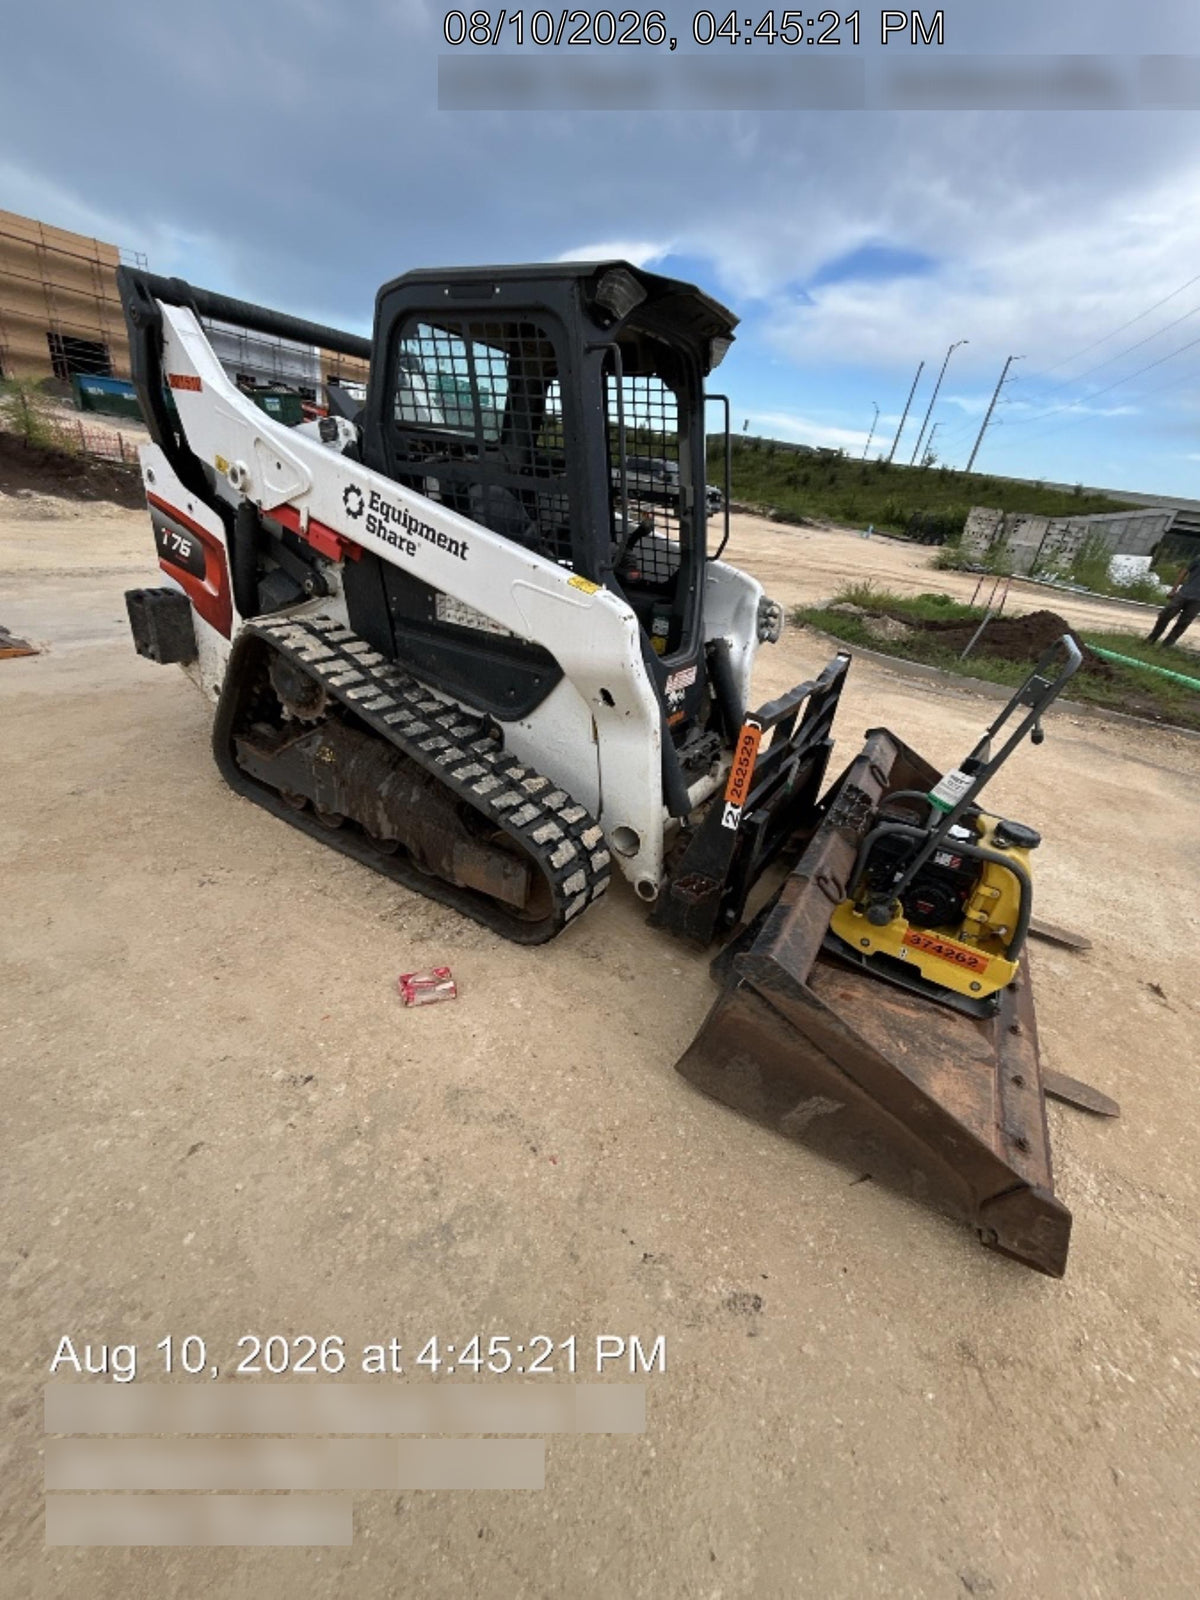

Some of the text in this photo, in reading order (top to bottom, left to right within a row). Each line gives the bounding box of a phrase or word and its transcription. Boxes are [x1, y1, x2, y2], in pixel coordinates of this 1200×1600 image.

[161, 527, 192, 557] T76
[365, 513, 417, 557] Share
[368, 490, 470, 561] Equipment
[730, 735, 755, 799] 262529
[910, 934, 979, 968] 374262
